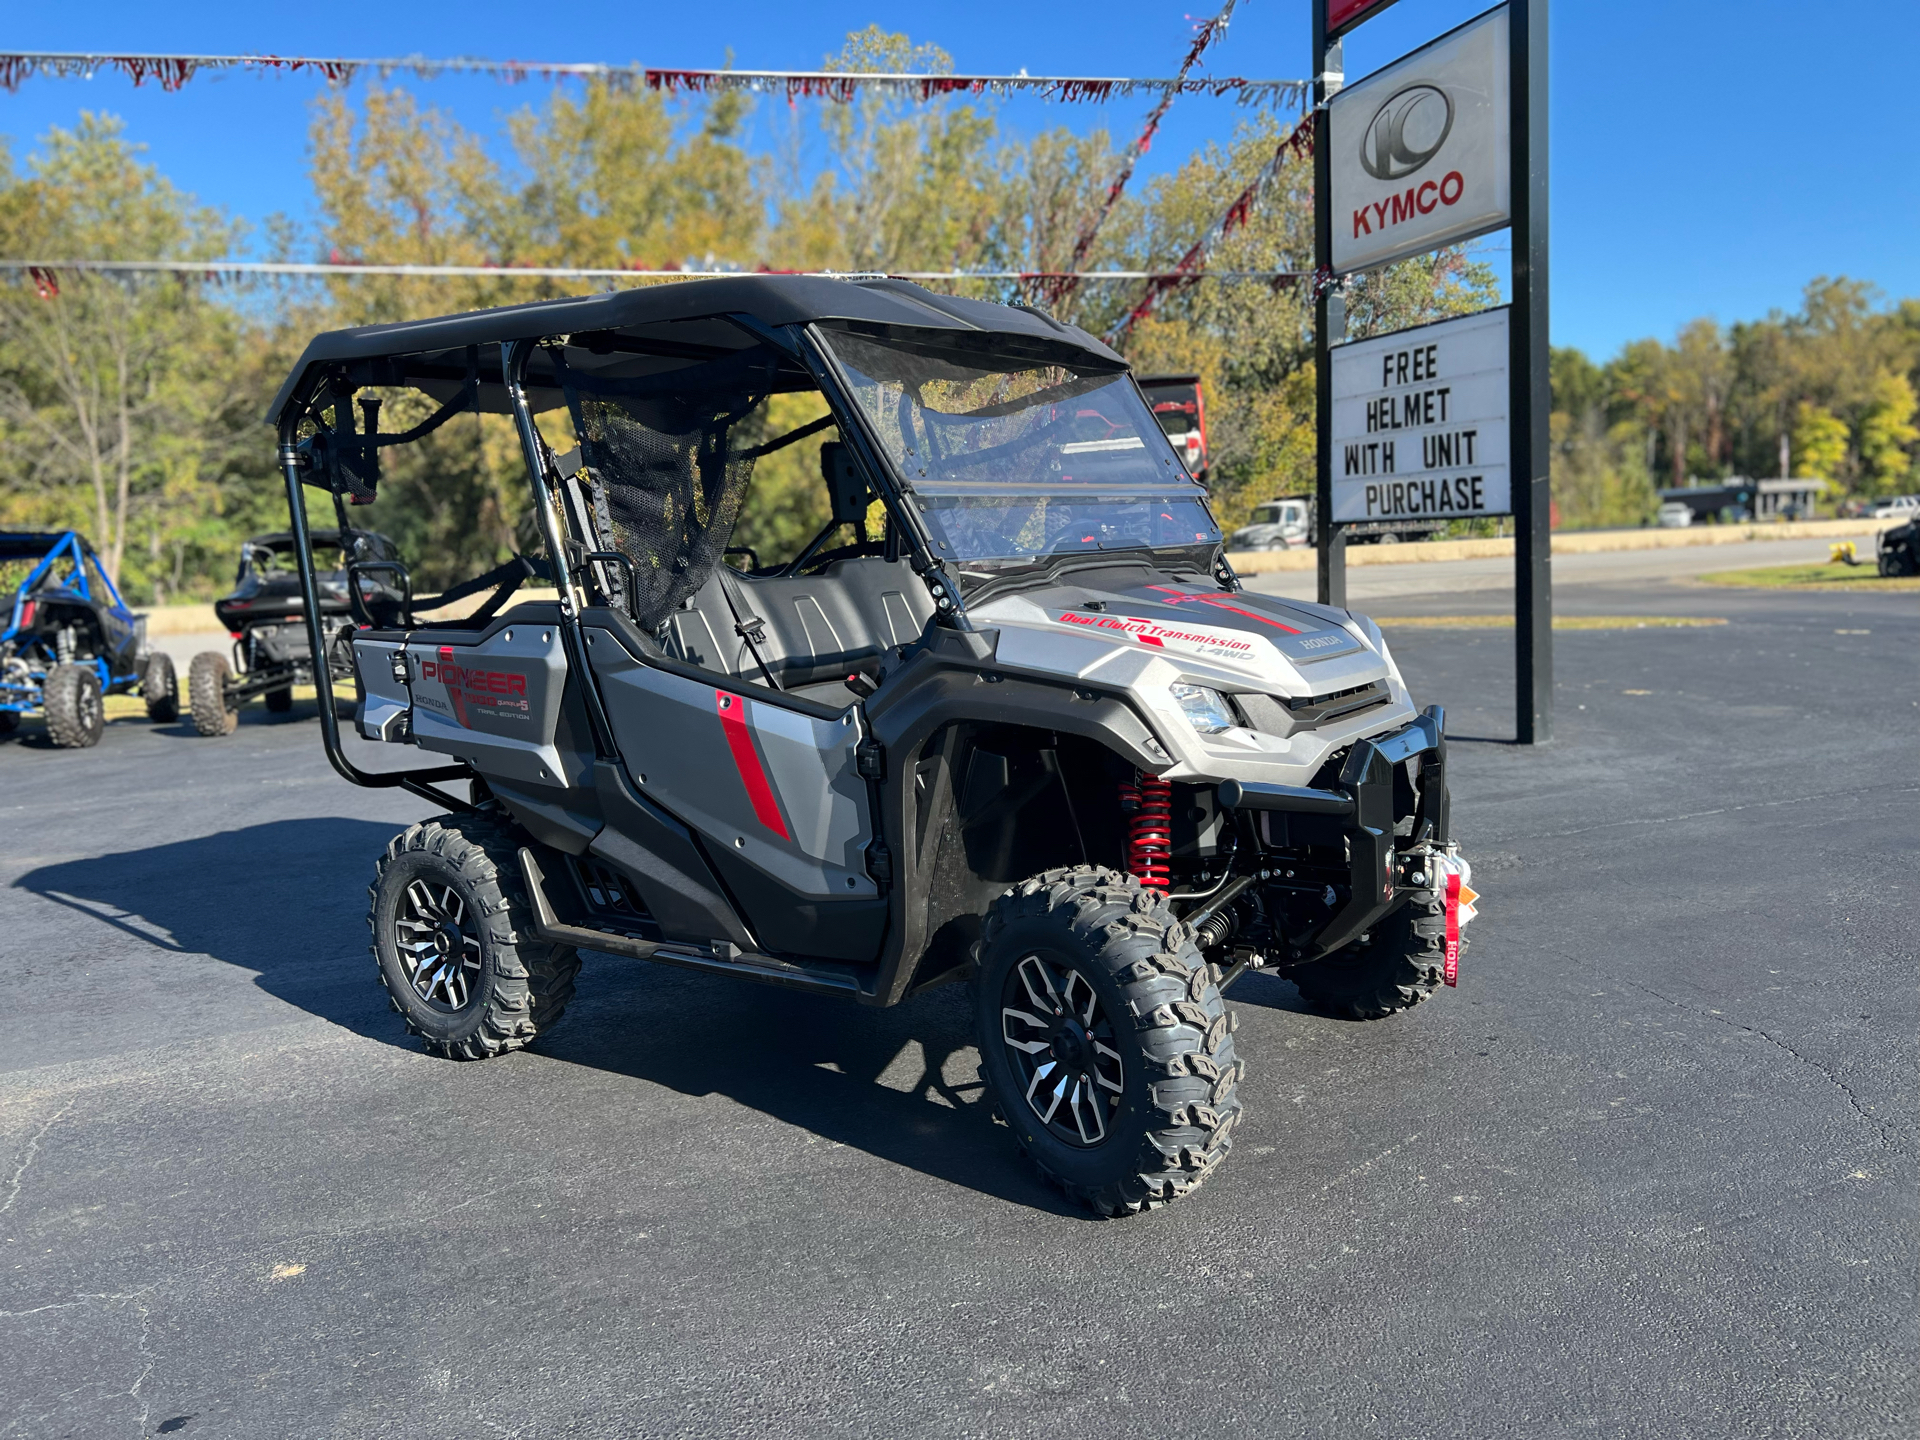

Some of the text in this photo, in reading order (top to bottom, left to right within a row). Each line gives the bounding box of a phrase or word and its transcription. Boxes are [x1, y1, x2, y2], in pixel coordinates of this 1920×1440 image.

[1353, 171, 1464, 239] KYMCO
[1383, 345, 1437, 387] FREE
[1367, 387, 1450, 433] HELMET
[1345, 430, 1477, 475] WITH UNIT
[1366, 476, 1484, 516] PURCHASE
[1059, 613, 1251, 650] Dual Clutch Transmission
[1299, 635, 1344, 650] HONDA
[421, 661, 527, 697] PIONEER
[415, 694, 449, 711] HONDA
[477, 708, 530, 721] TRAIL EDITION
